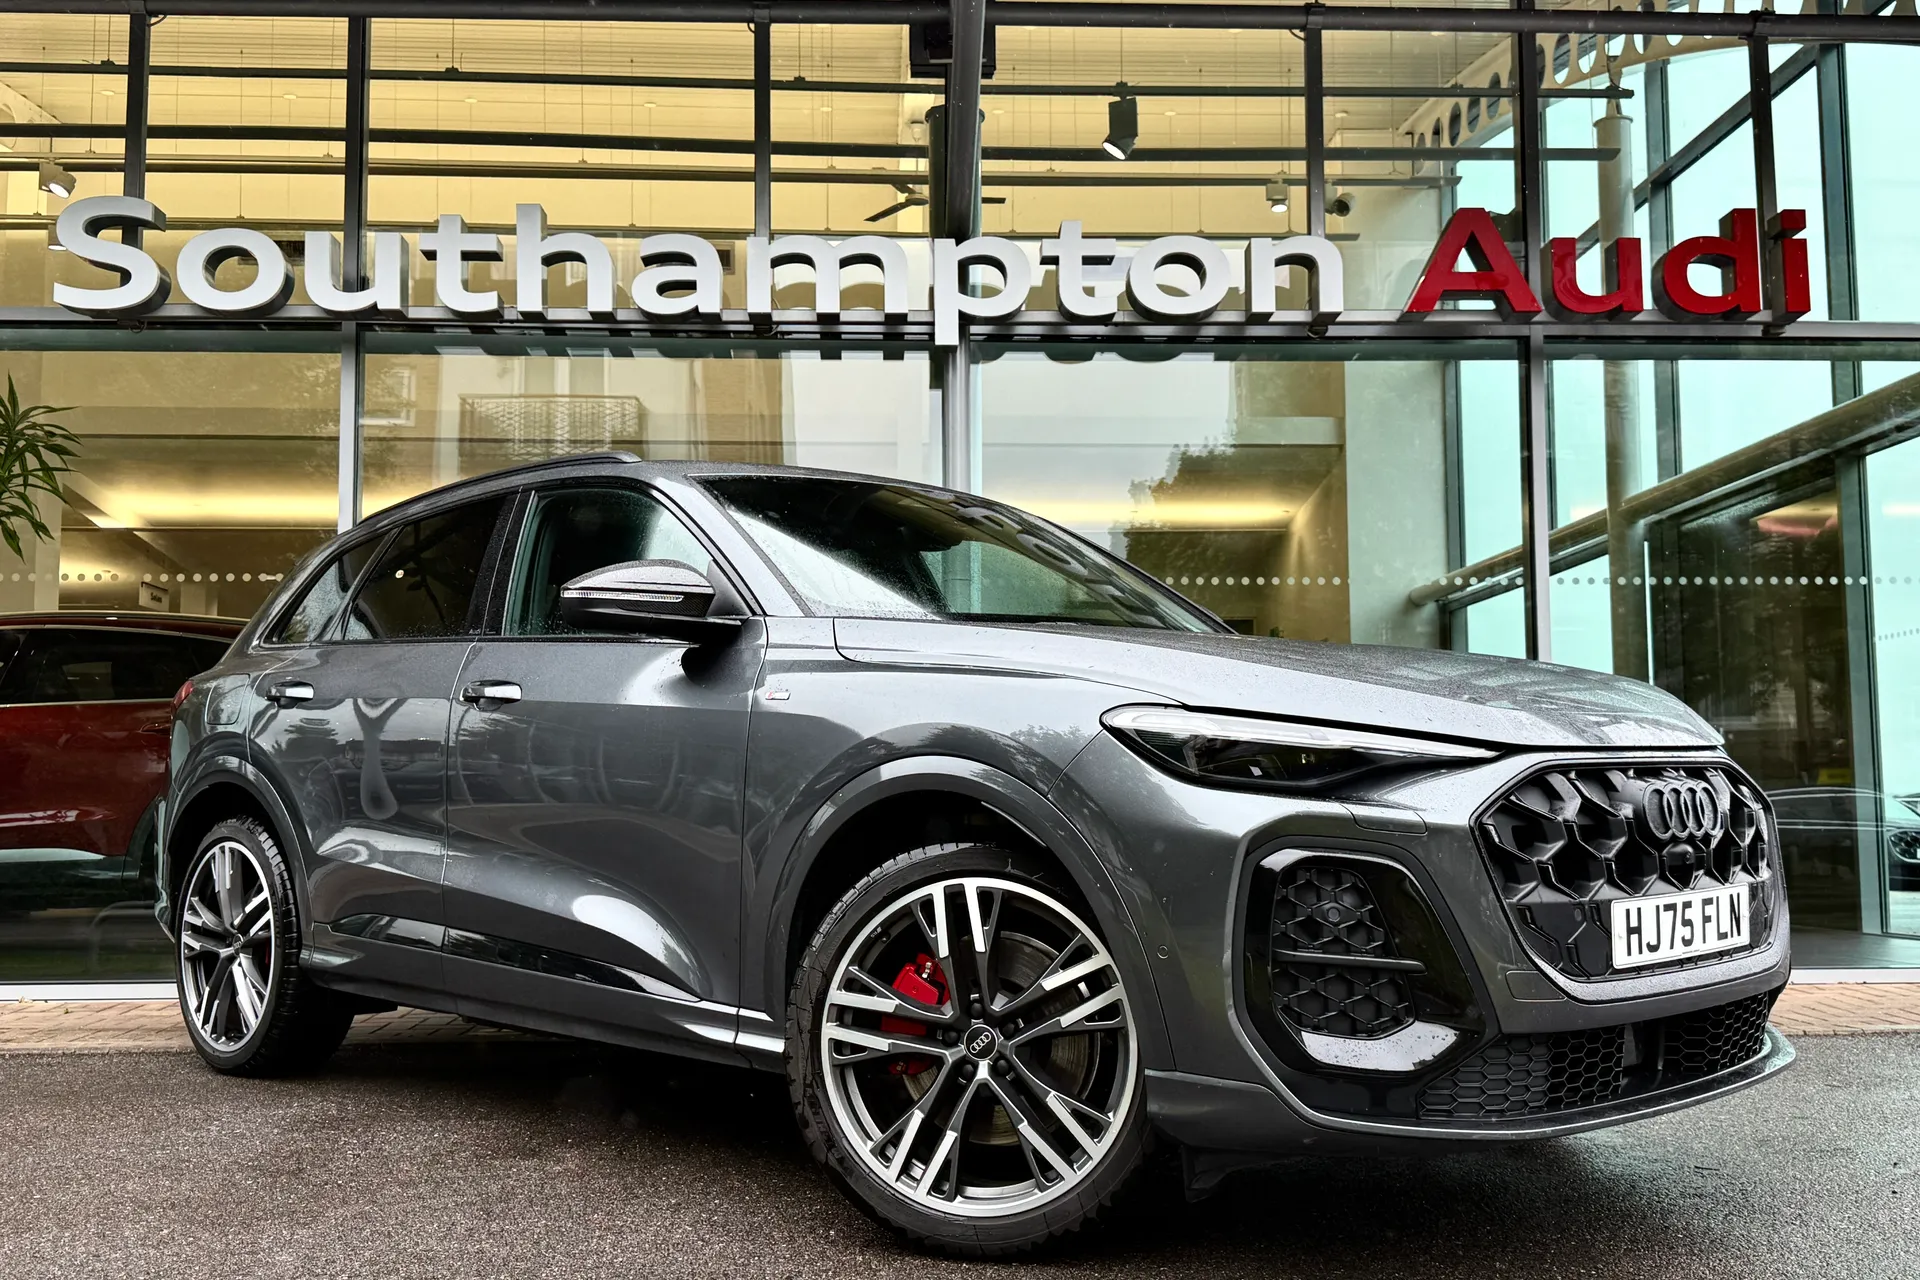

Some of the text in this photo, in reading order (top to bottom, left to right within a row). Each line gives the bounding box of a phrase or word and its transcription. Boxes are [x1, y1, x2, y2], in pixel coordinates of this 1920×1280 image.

[53, 195, 1812, 346] Southampton Audi
[1625, 892, 1741, 957] HJ75 FLN
